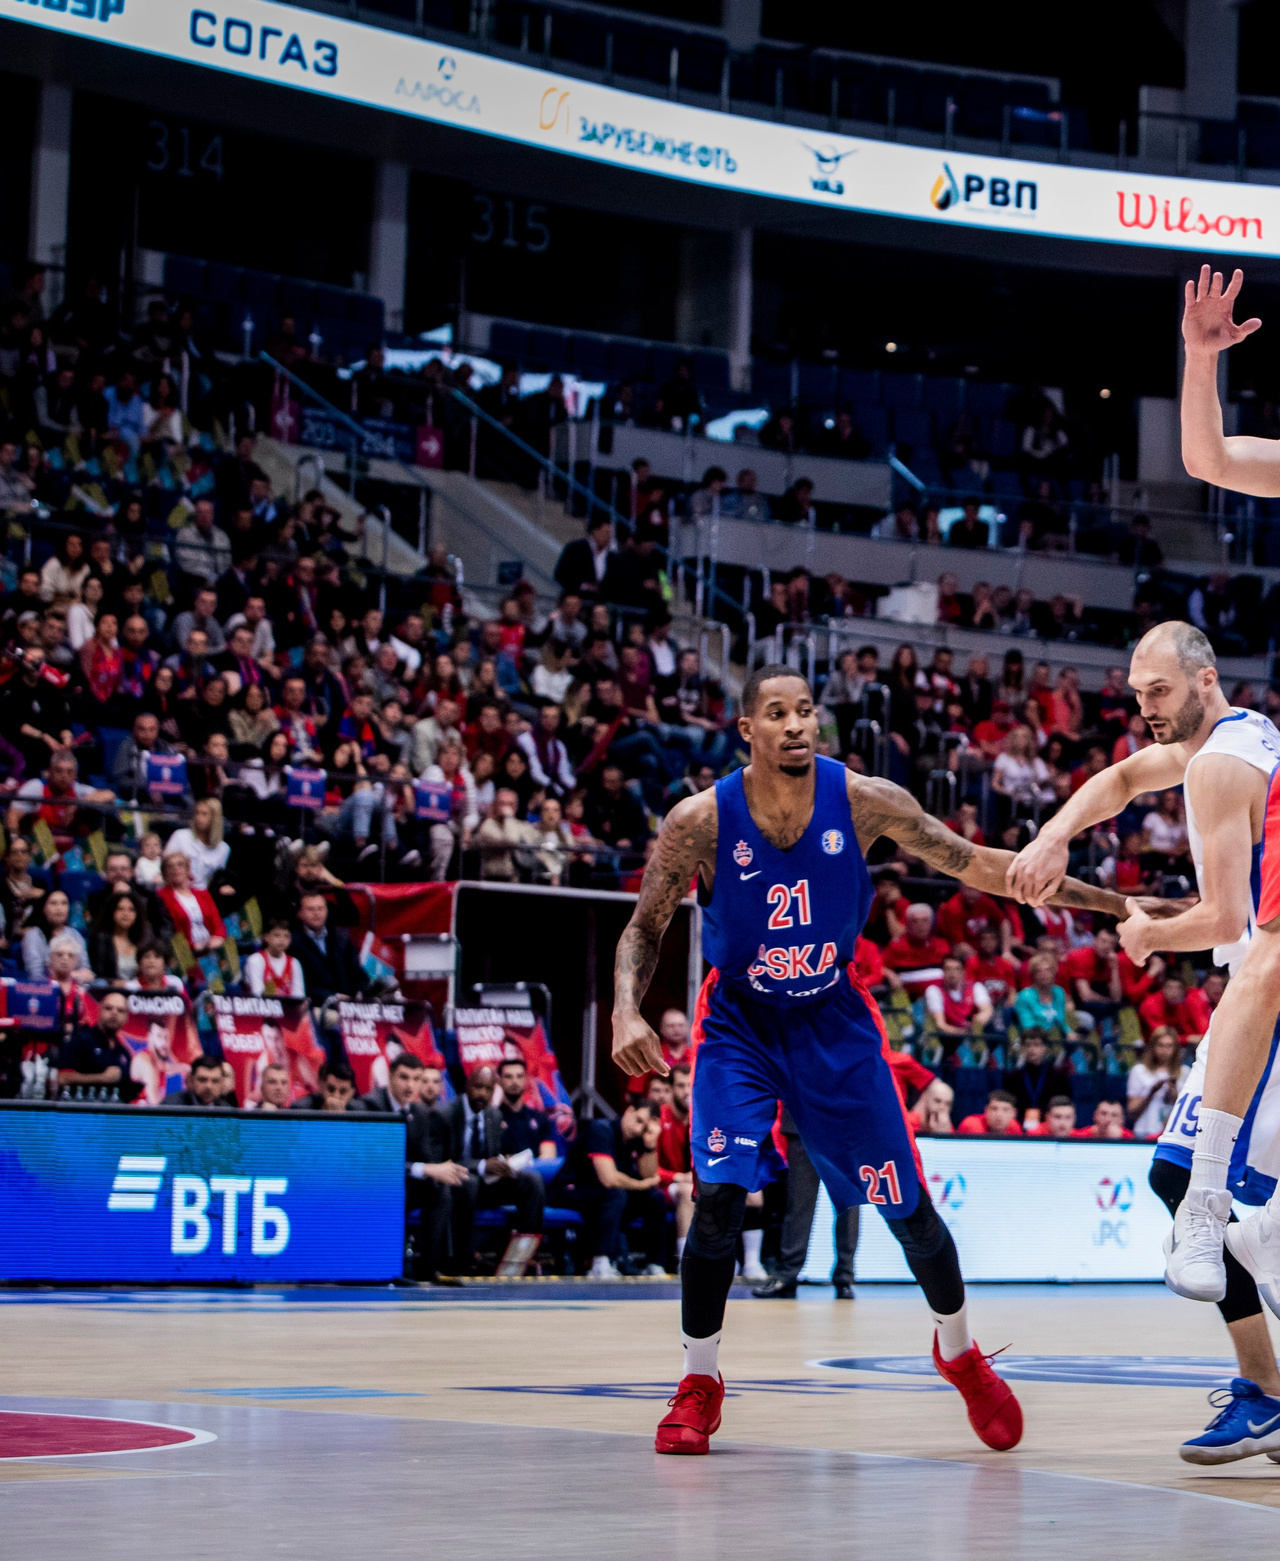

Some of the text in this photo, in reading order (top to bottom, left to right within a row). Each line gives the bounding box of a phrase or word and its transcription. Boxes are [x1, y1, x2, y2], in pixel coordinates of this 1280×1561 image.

[190, 8, 338, 76] СОГАЗ
[147, 120, 225, 181] 314
[964, 173, 1037, 210] РВП
[1116, 190, 1263, 240] Wilson
[470, 195, 550, 252] 315
[767, 879, 811, 930] 21
[1168, 1092, 1202, 1137] 19
[858, 1161, 902, 1205] 21
[170, 1174, 291, 1256] ВТБ
